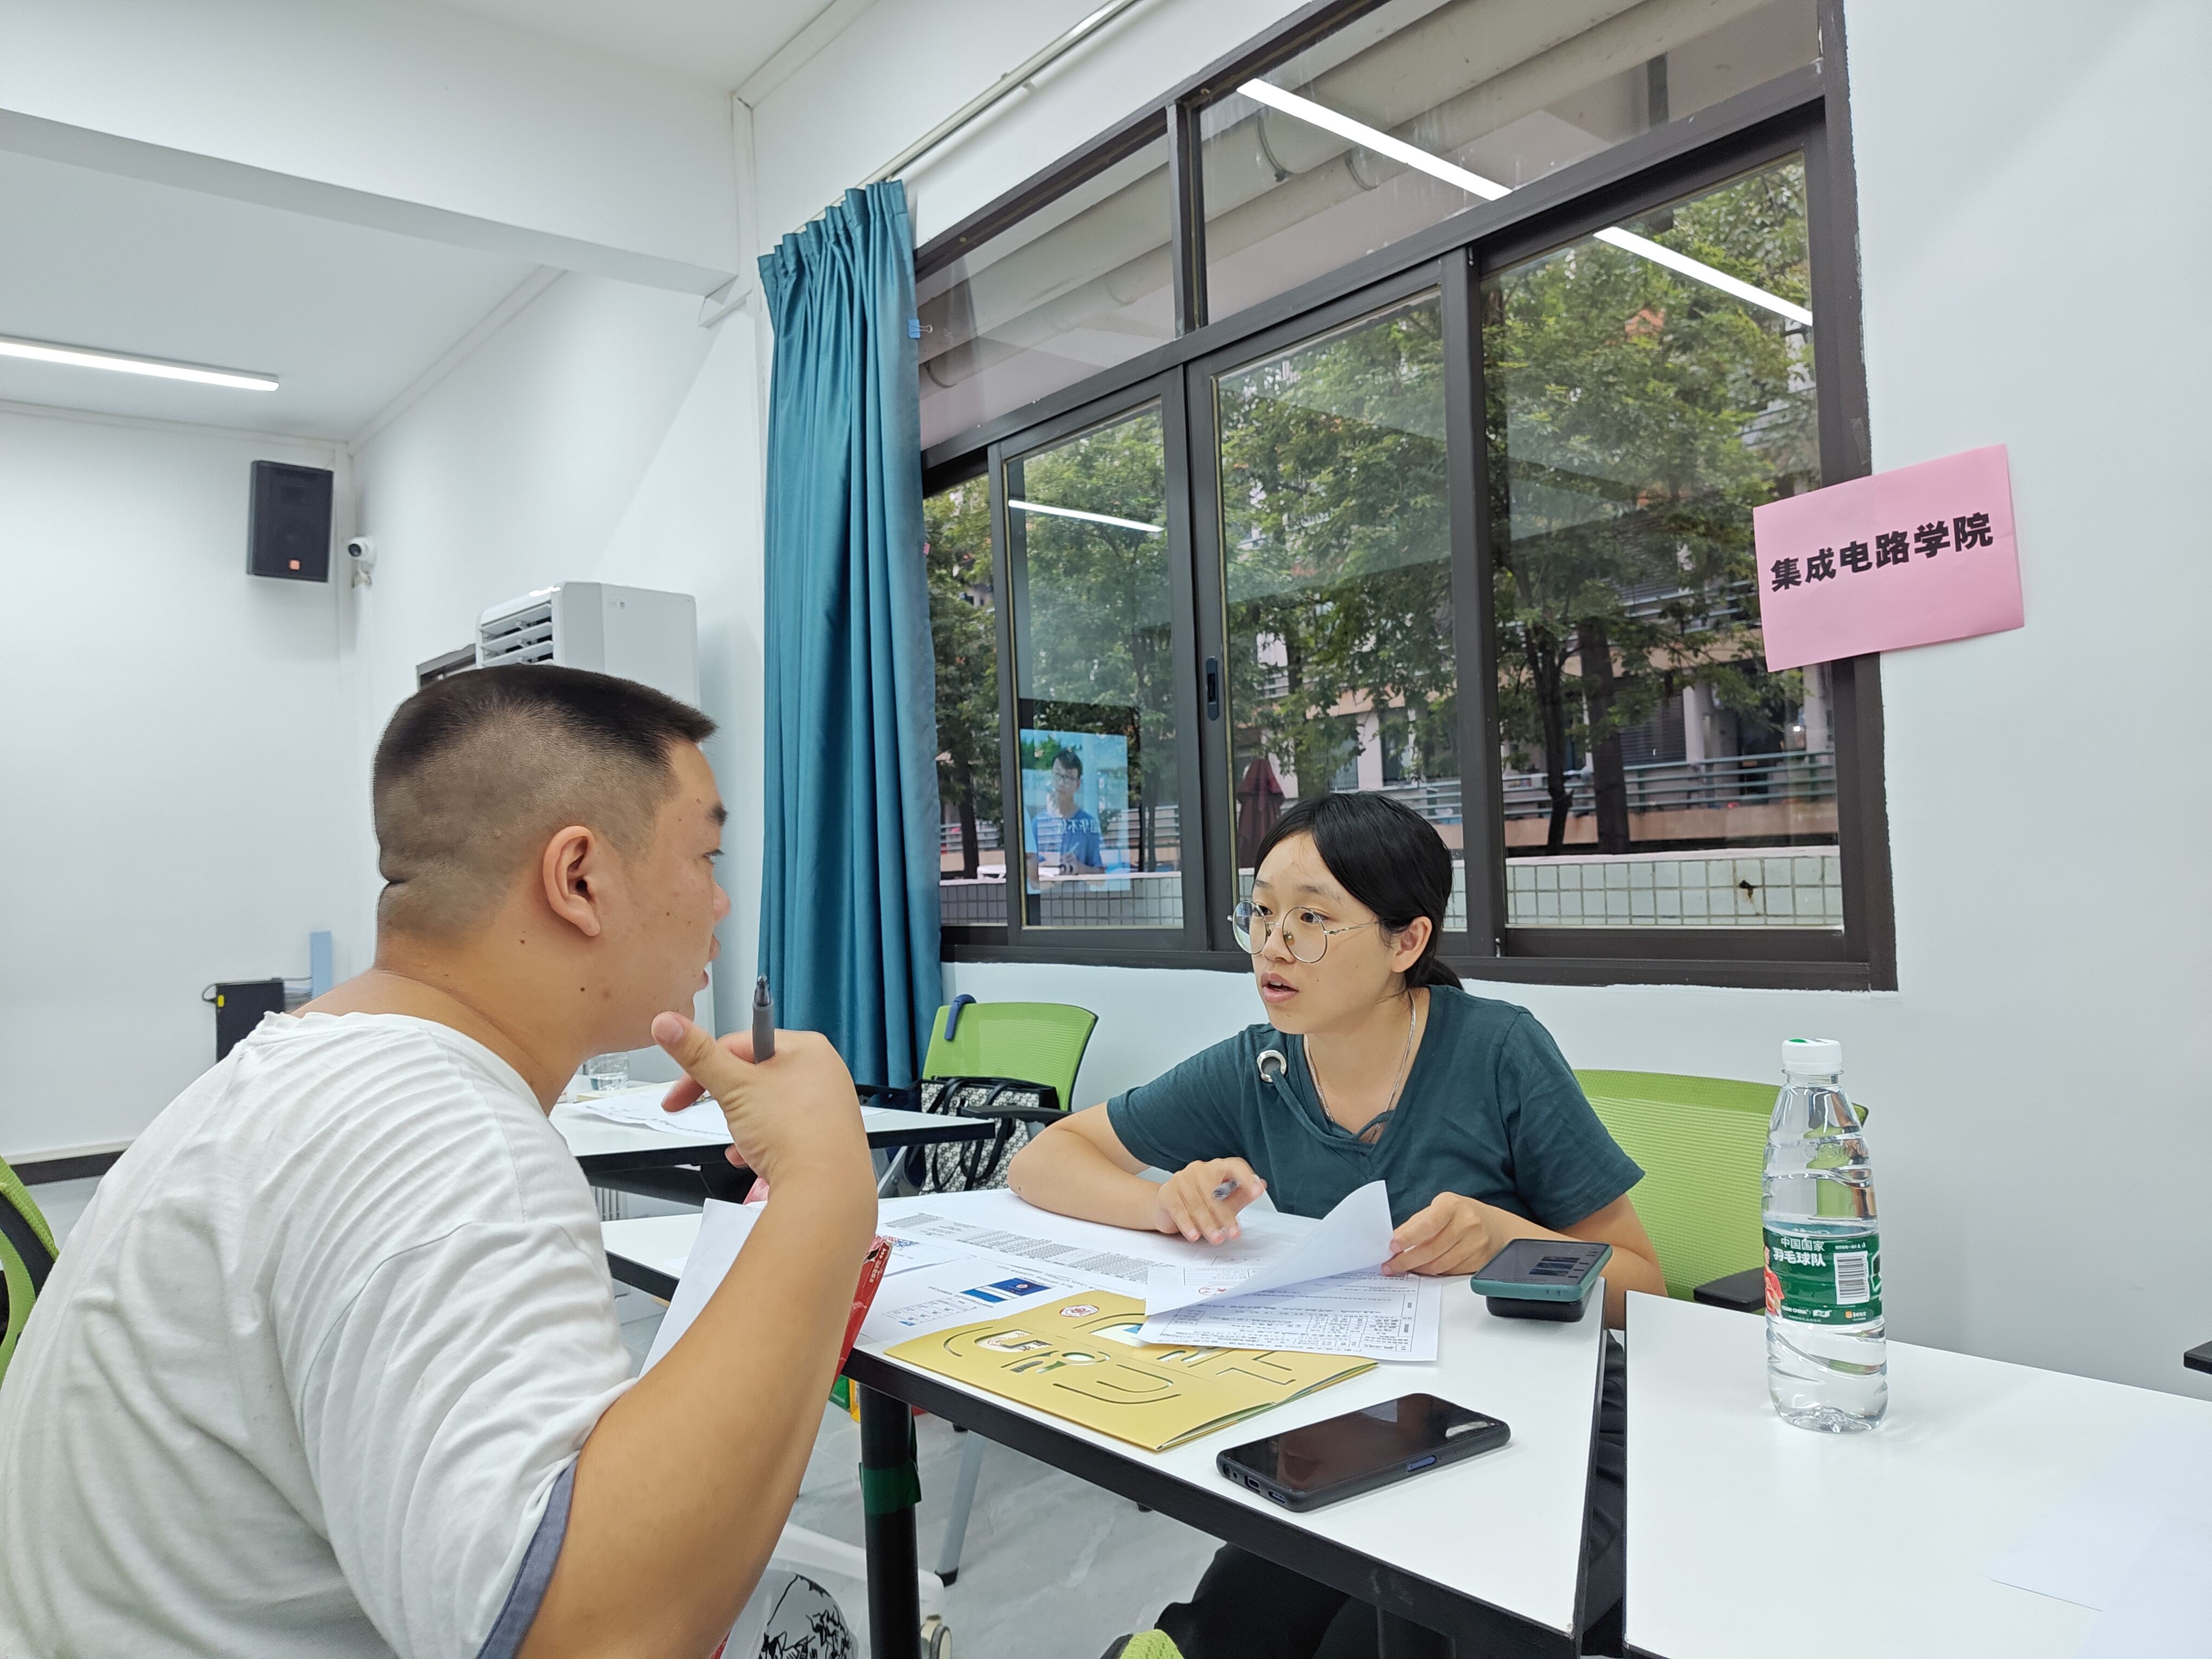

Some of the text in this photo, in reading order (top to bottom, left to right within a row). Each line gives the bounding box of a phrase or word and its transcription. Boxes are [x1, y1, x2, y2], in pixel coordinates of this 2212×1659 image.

[1771, 512, 1994, 592] 集成电路学院
[1780, 1236, 1825, 1251] 中国国家
[1773, 1246, 1827, 1267] 羽毛球队
